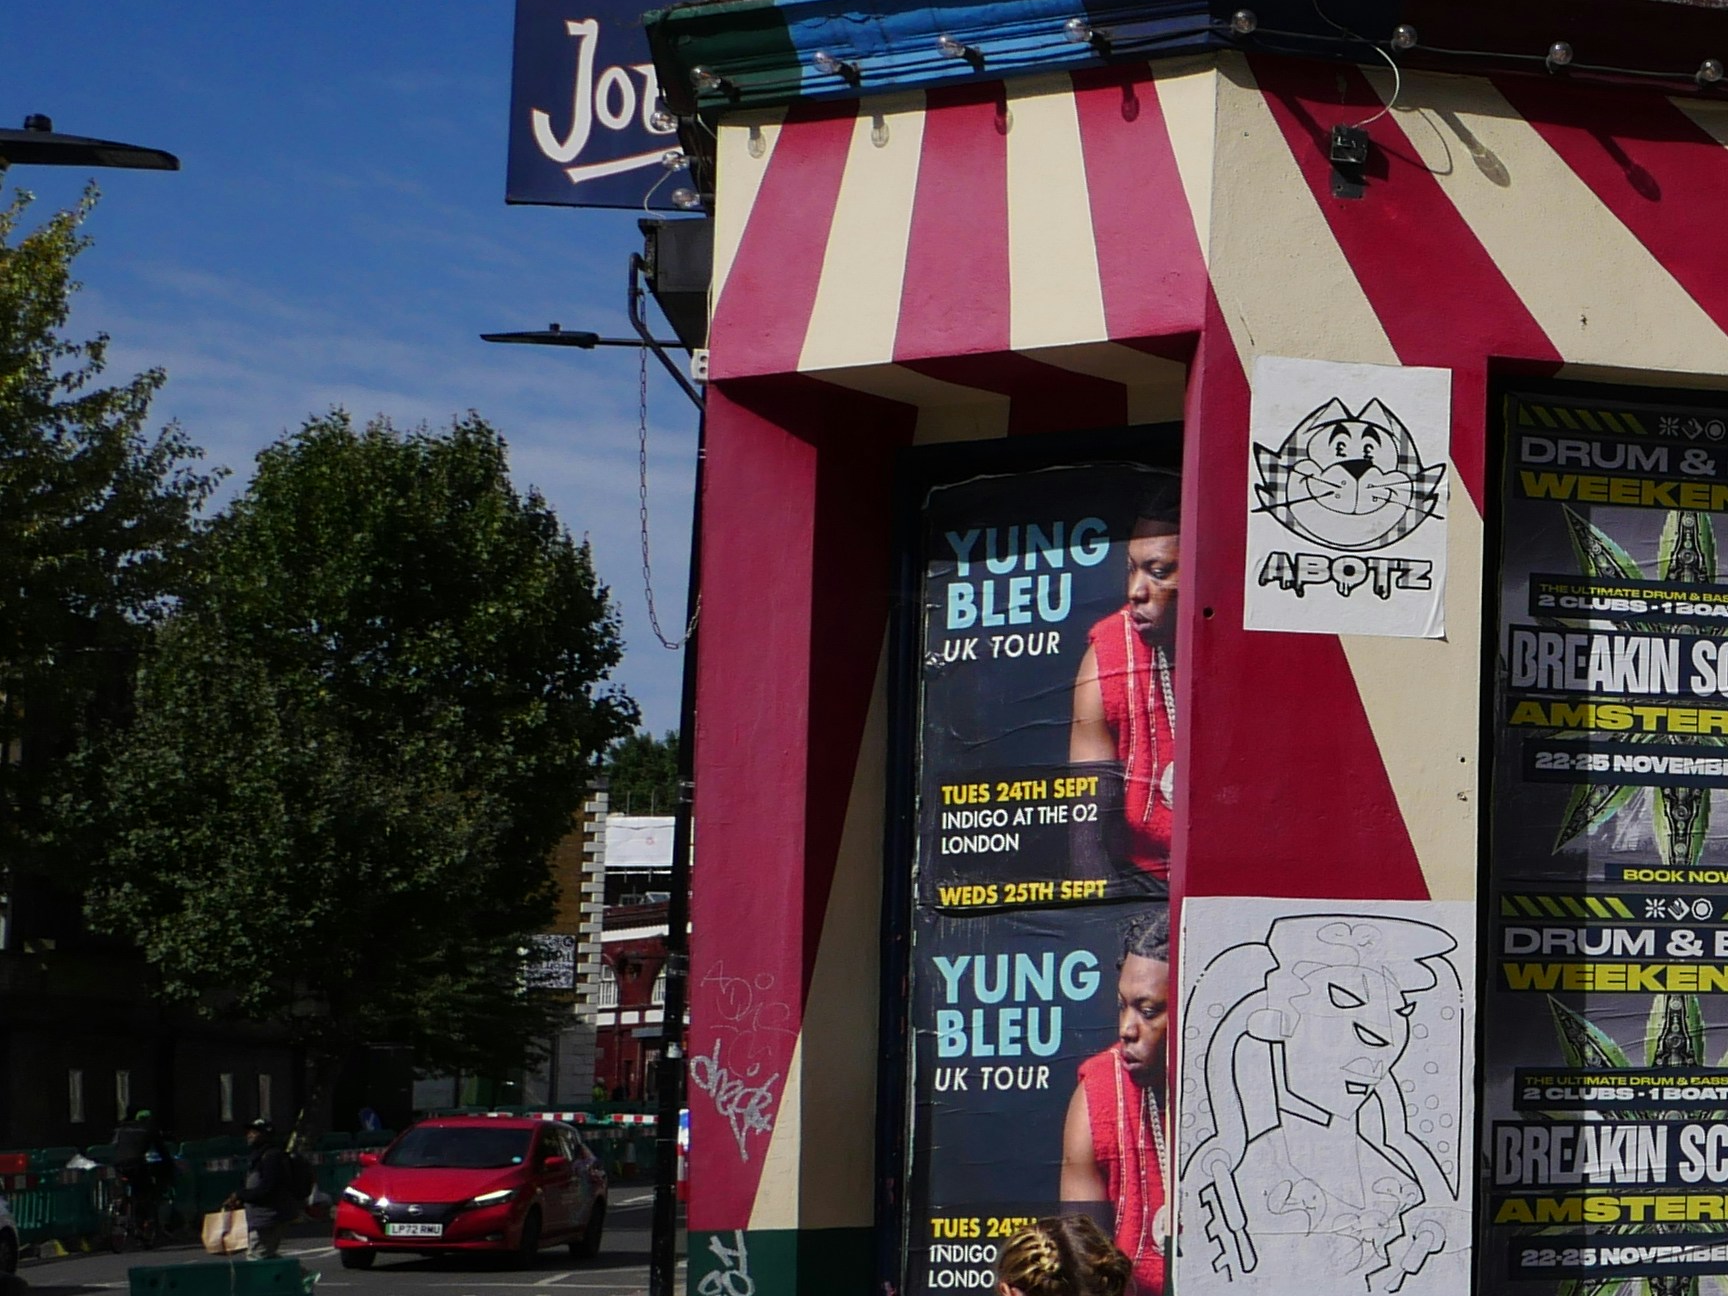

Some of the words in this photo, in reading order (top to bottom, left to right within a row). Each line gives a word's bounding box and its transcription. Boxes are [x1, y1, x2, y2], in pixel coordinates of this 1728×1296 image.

[1521, 436, 1668, 473] DRUM
[1680, 448, 1716, 475] &
[945, 517, 1110, 578] YUNG
[1258, 551, 1433, 600] ABOTZ
[947, 573, 1073, 630] BLEU
[1538, 594, 1556, 607] 2
[1559, 596, 1648, 614] CLUBS
[1539, 583, 1569, 594] THE
[1570, 584, 1641, 599] ULTIMATE
[1643, 589, 1687, 601] DRUM
[1689, 592, 1701, 602] &
[943, 637, 977, 663] UK
[991, 631, 1060, 659] TOUR
[1511, 631, 1680, 694] BREAKIN
[1535, 752, 1610, 770] 22-25
[941, 783, 990, 805] TUES
[996, 780, 1047, 802] 24TH
[1052, 776, 1098, 799] SEPT
[941, 809, 1009, 831] INDIGO
[1012, 807, 1034, 827] AT
[1037, 805, 1069, 826] THE
[941, 832, 1020, 855] LONDON
[1623, 868, 1684, 882] BOOK
[938, 885, 998, 907] WEDS
[1003, 882, 1056, 904] 25TH
[1060, 879, 1107, 902] SEPT
[1504, 929, 1655, 955] DRUM
[1666, 929, 1704, 956] &
[932, 949, 1101, 1005] YUNG
[936, 1006, 1063, 1059] BLEU
[934, 1067, 969, 1093] UK
[980, 1065, 1050, 1091] TOUR
[1524, 1076, 1555, 1085] THE
[1556, 1076, 1628, 1086] ULTIMATE
[1629, 1076, 1676, 1086] DRUM
[1677, 1076, 1689, 1086] &
[1523, 1087, 1542, 1100] 2
[1545, 1087, 1635, 1100] CLUBS
[1496, 1124, 1667, 1185] BREAKIN
[931, 1217, 980, 1238] TUES
[929, 1244, 998, 1264] INDIGO
[1521, 1248, 1597, 1267] 22-25
[928, 1269, 995, 1288] LONDO
